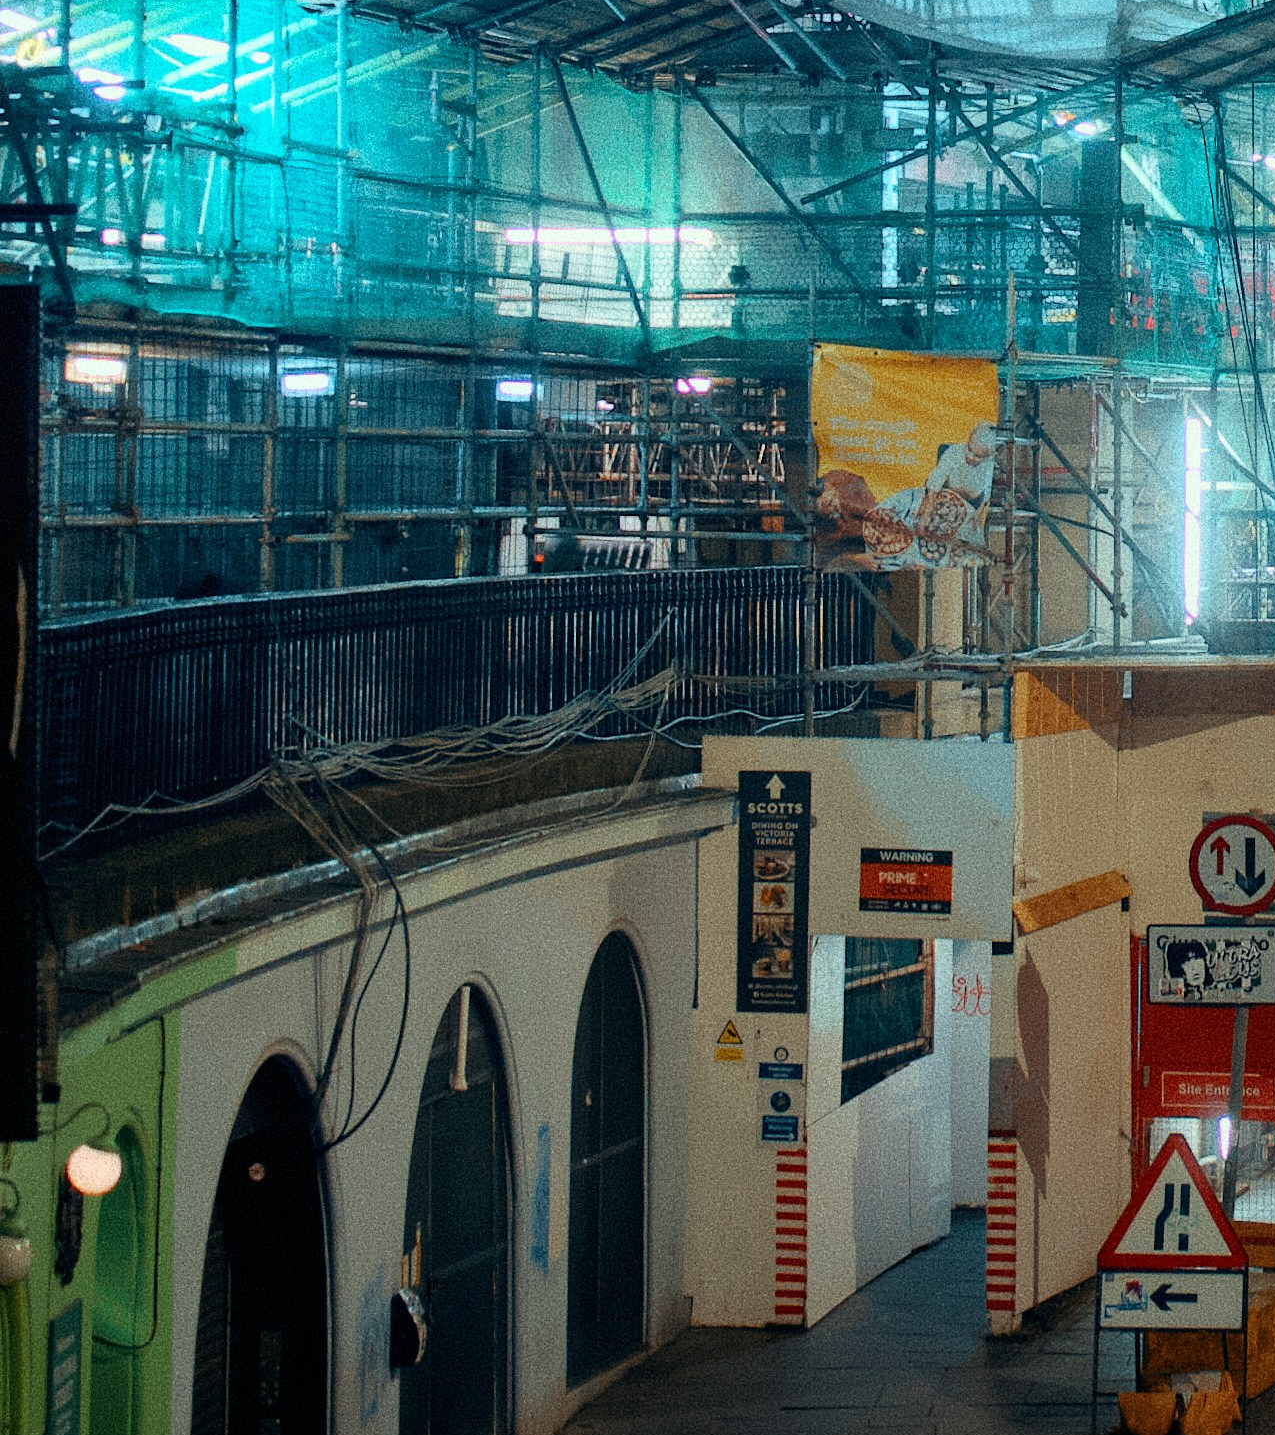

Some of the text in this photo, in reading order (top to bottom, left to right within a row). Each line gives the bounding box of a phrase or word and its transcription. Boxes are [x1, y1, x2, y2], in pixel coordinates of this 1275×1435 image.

[747, 802, 804, 815] SCOTTS
[751, 821, 799, 830] DINING ON
[754, 829, 796, 838] VICTORIA
[755, 837, 795, 847] TERRACE
[879, 850, 934, 863] WARNING
[878, 870, 918, 885] PRIME
[1177, 1082, 1202, 1096] Site
